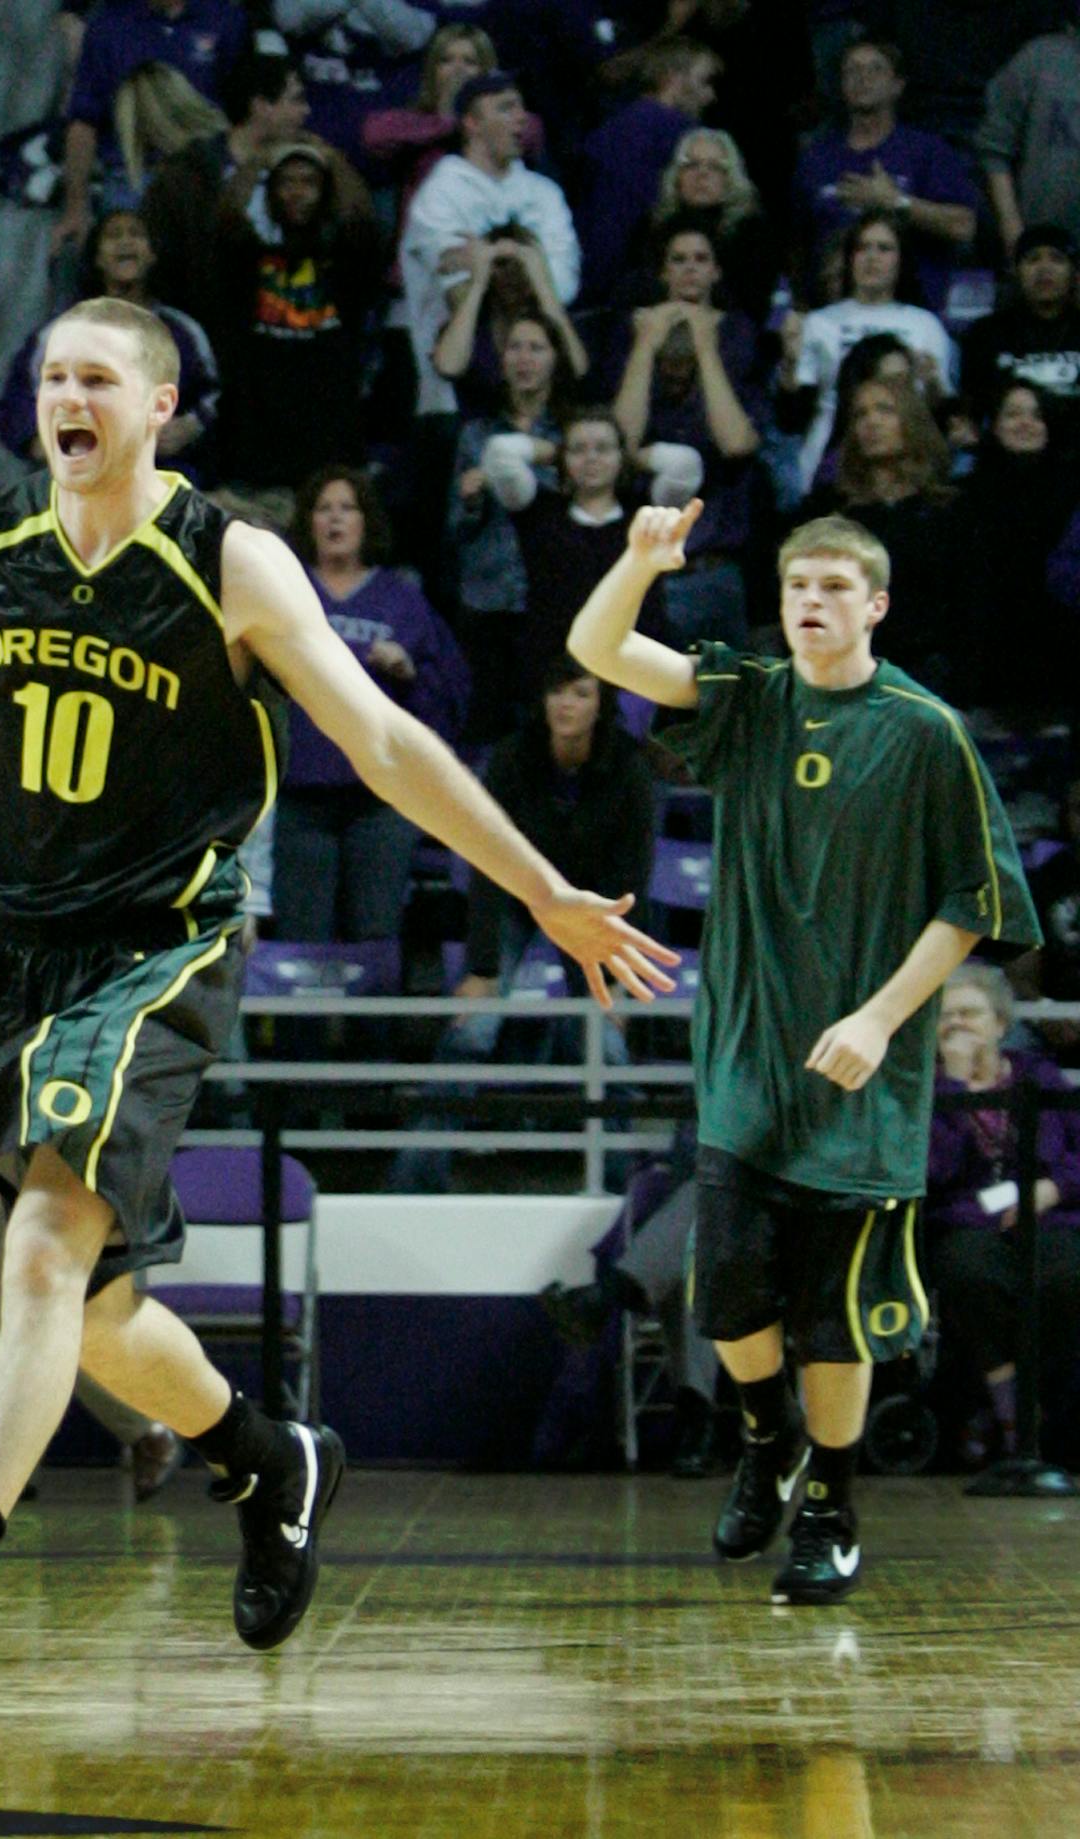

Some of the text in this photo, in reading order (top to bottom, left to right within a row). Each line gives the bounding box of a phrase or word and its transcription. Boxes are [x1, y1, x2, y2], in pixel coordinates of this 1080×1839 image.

[13, 681, 115, 803] 10
[796, 752, 832, 788] O
[39, 1080, 92, 1125] O
[870, 1301, 909, 1337] O
